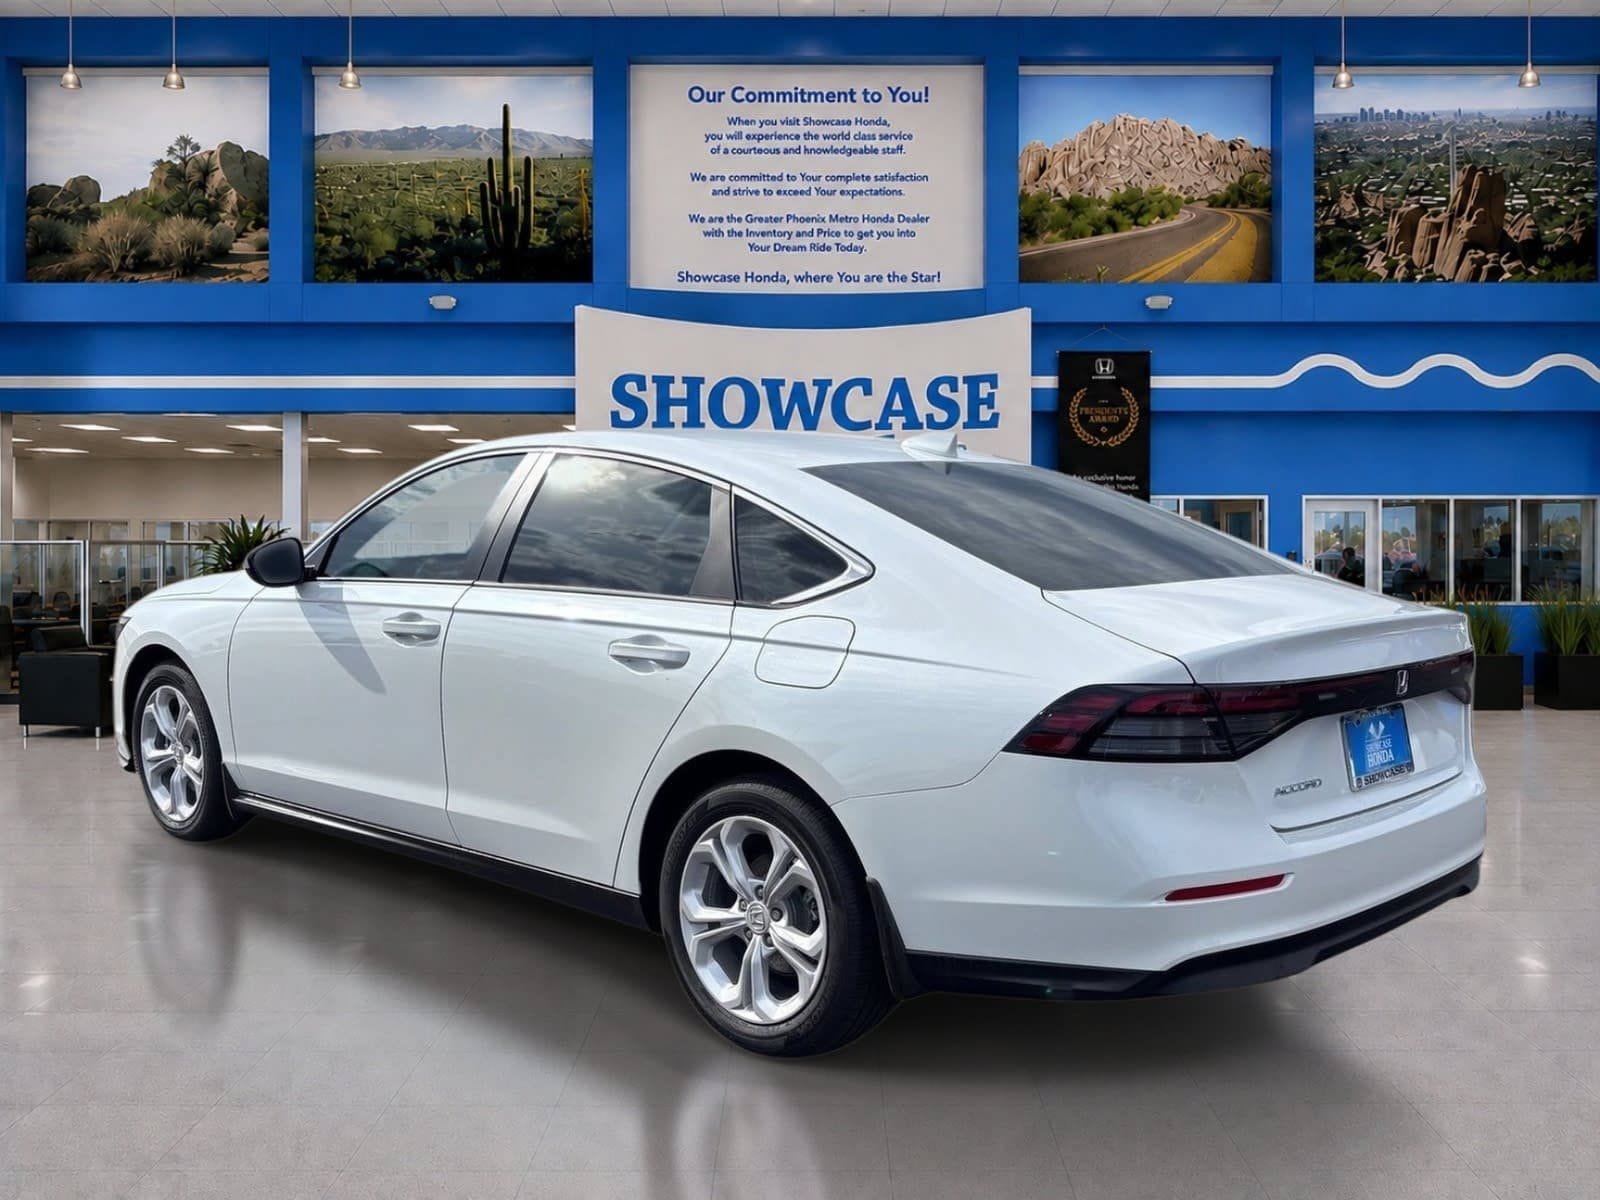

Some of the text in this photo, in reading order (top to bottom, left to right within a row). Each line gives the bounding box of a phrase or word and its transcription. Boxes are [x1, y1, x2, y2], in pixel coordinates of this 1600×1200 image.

[688, 86, 929, 103] Our Commitment to You!
[727, 117, 890, 129] When you visit Showcase Honda,
[705, 131, 913, 143] you will experience the world class service
[710, 145, 720, 155] of
[731, 146, 781, 155] courteous
[783, 145, 801, 155] and
[881, 144, 906, 155] staff.
[690, 172, 928, 184] We are committed to Your complete satisfaction
[712, 186, 905, 198] and strive to exceed Your expectations.
[688, 213, 930, 224] We are the Greater Phoenix Metro Honda Dealer
[703, 228, 916, 240] with the Inventory and Price to get you into
[748, 243, 867, 254] Your Dream Ride Today.
[677, 271, 940, 285] Showcase Honda, where You are the Star!
[610, 373, 1000, 431] SHOWCASE
[1367, 749, 1395, 768] HONDA
[1364, 766, 1407, 785] SHOWCASE
